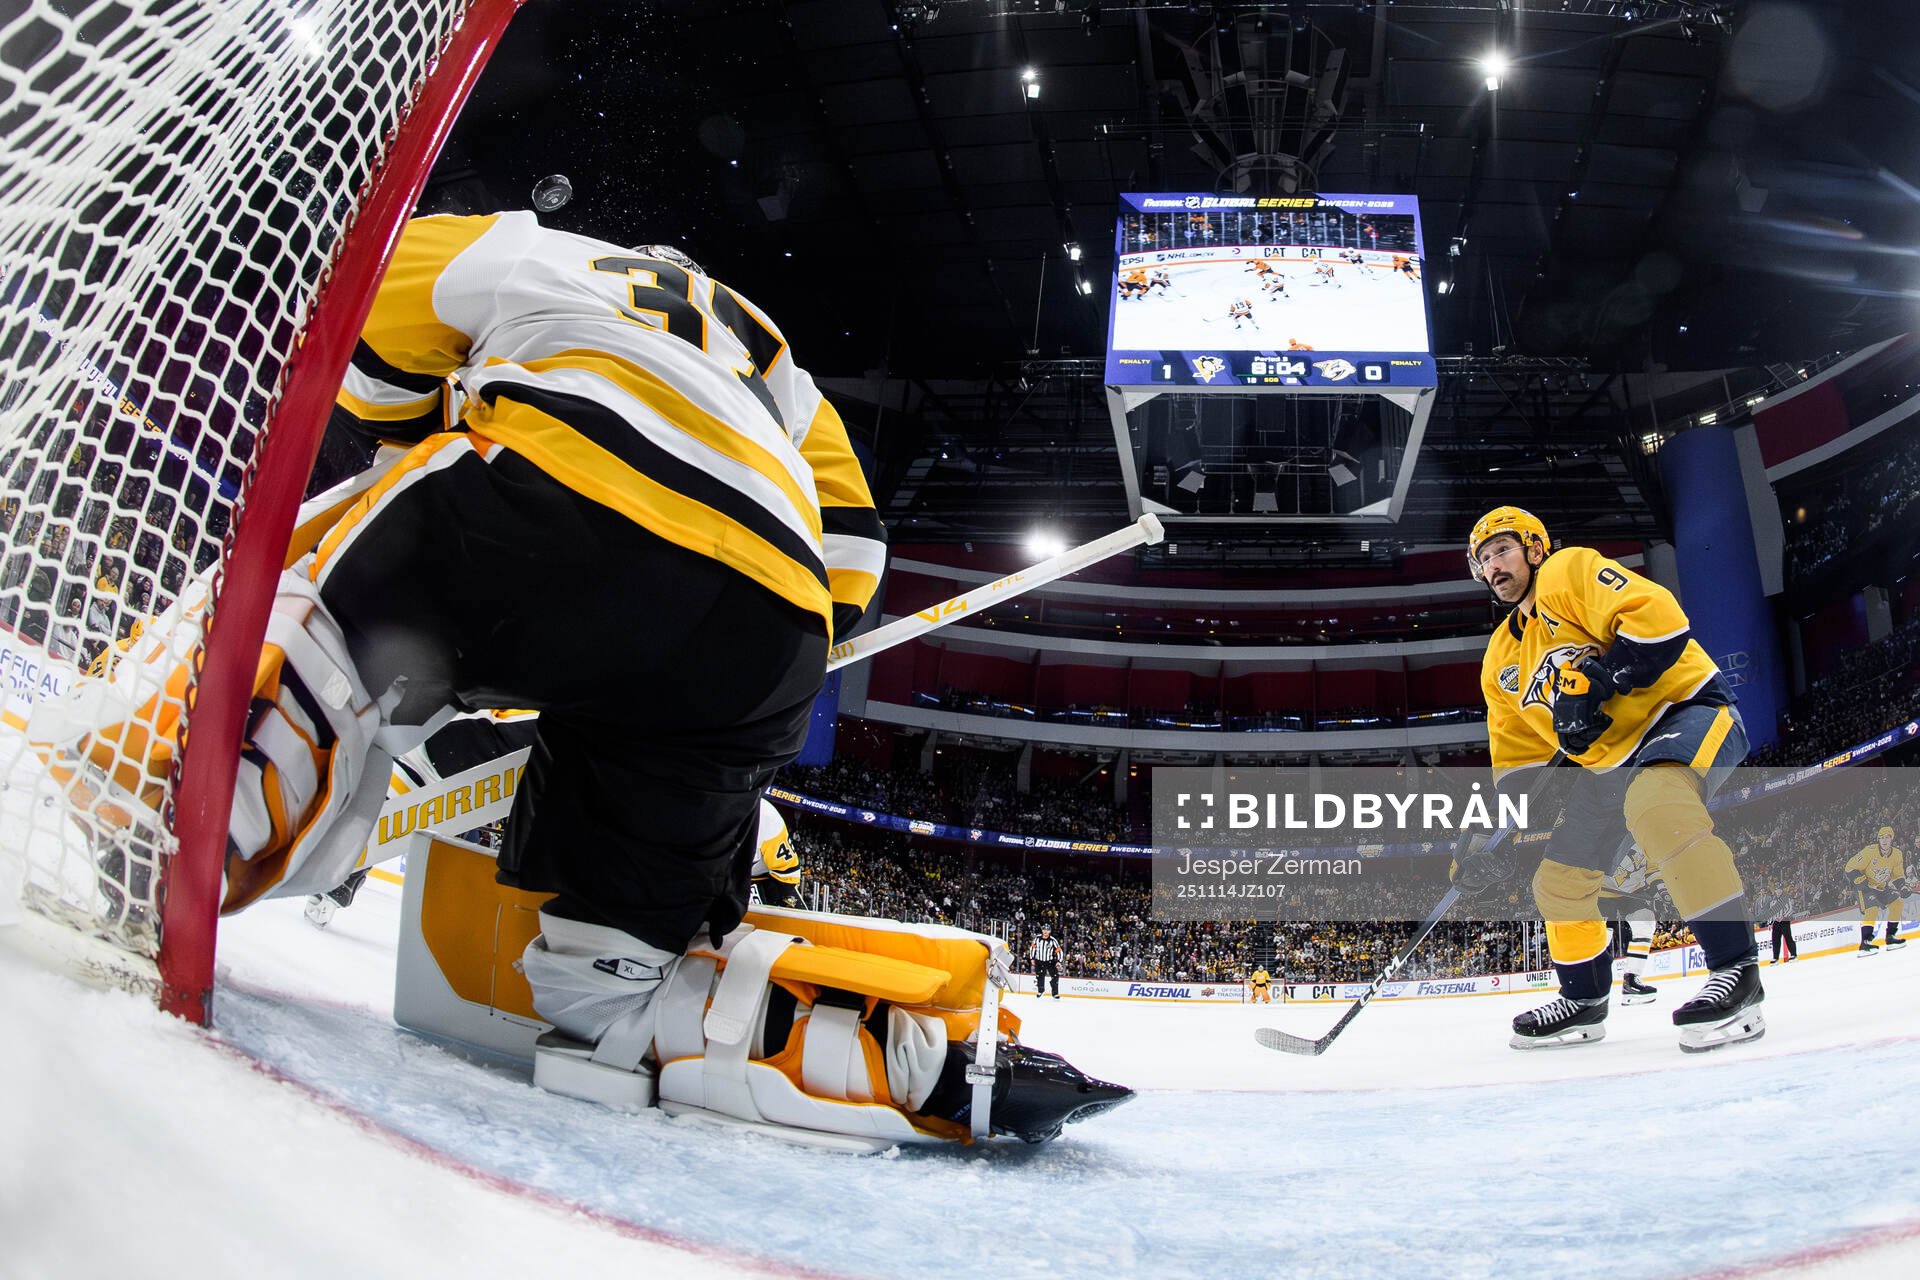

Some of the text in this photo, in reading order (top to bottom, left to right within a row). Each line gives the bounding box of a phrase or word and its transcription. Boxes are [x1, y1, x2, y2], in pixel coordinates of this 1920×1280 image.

[1200, 197, 1257, 208] GLOBAL
[1257, 198, 1315, 208] SERIES
[1162, 364, 1172, 379] 1
[1364, 365, 1382, 381] 0
[1597, 566, 1630, 593] 9
[915, 597, 967, 624] V4
[1540, 609, 1561, 637] A
[1796, 763, 1823, 783] GLOBAL
[1823, 751, 1852, 770] SERIES
[770, 788, 801, 804] SERIES
[1523, 831, 1553, 843] SERIE
[1035, 838, 1071, 850] GLOBAL
[1071, 842, 1109, 853] SERIES
[624, 965, 635, 975] XL
[1526, 971, 1552, 983] UNIBET
[1128, 983, 1191, 998] FASTENAL
[1312, 985, 1336, 999] CAT
[1382, 984, 1403, 995] SAP
[1417, 981, 1477, 996] FASTENAL
